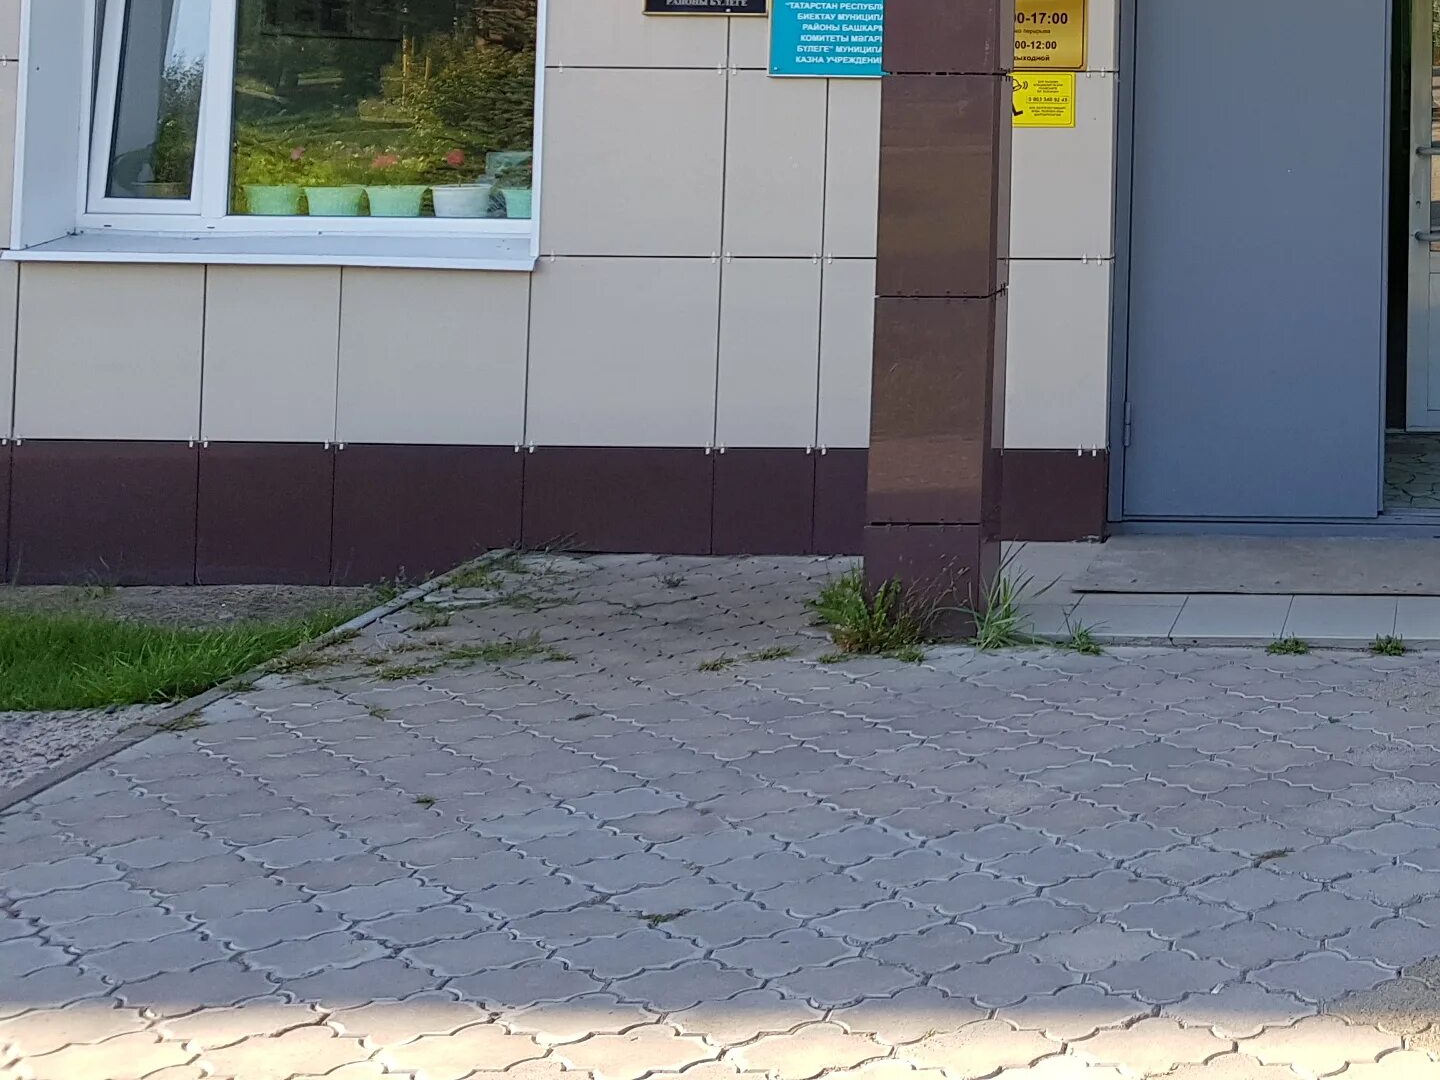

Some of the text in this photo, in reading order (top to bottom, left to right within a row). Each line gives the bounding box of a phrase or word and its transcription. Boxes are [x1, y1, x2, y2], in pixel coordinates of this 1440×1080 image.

[1015, 12, 1068, 24] 0-17:00
[803, 23, 840, 31] РАЙОНЫ
[1015, 41, 1057, 49] 00-12:00
